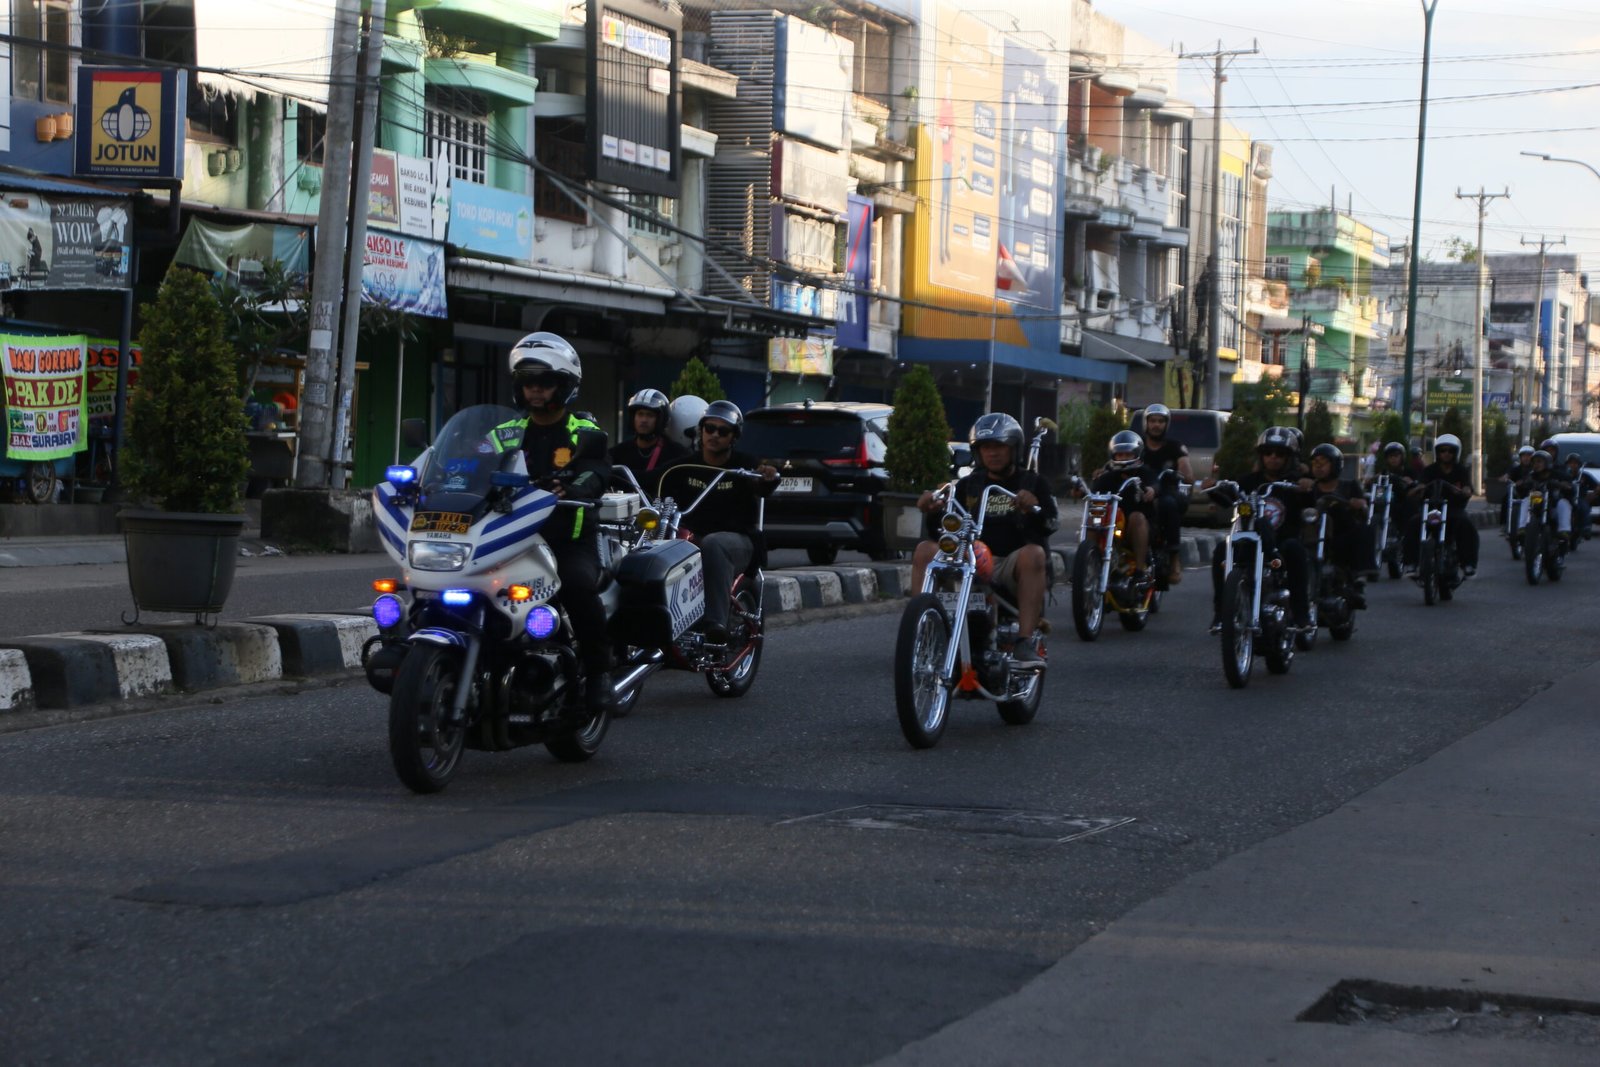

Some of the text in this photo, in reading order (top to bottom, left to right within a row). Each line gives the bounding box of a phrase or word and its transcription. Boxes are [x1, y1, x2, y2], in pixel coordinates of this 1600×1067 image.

[95, 143, 156, 162] JOTUN
[400, 167, 417, 179] BAKSO
[403, 182, 427, 195] MIE AYAM
[56, 202, 95, 218] SUMMER
[404, 196, 428, 208] KEBUMEN
[457, 202, 477, 220] TOKO
[479, 206, 496, 225] KOPI
[55, 221, 95, 244] WOW
[367, 235, 405, 257] AKSO LC
[372, 256, 385, 266] AYAM
[9, 347, 36, 373] NASI
[14, 379, 79, 406] PAK DE
